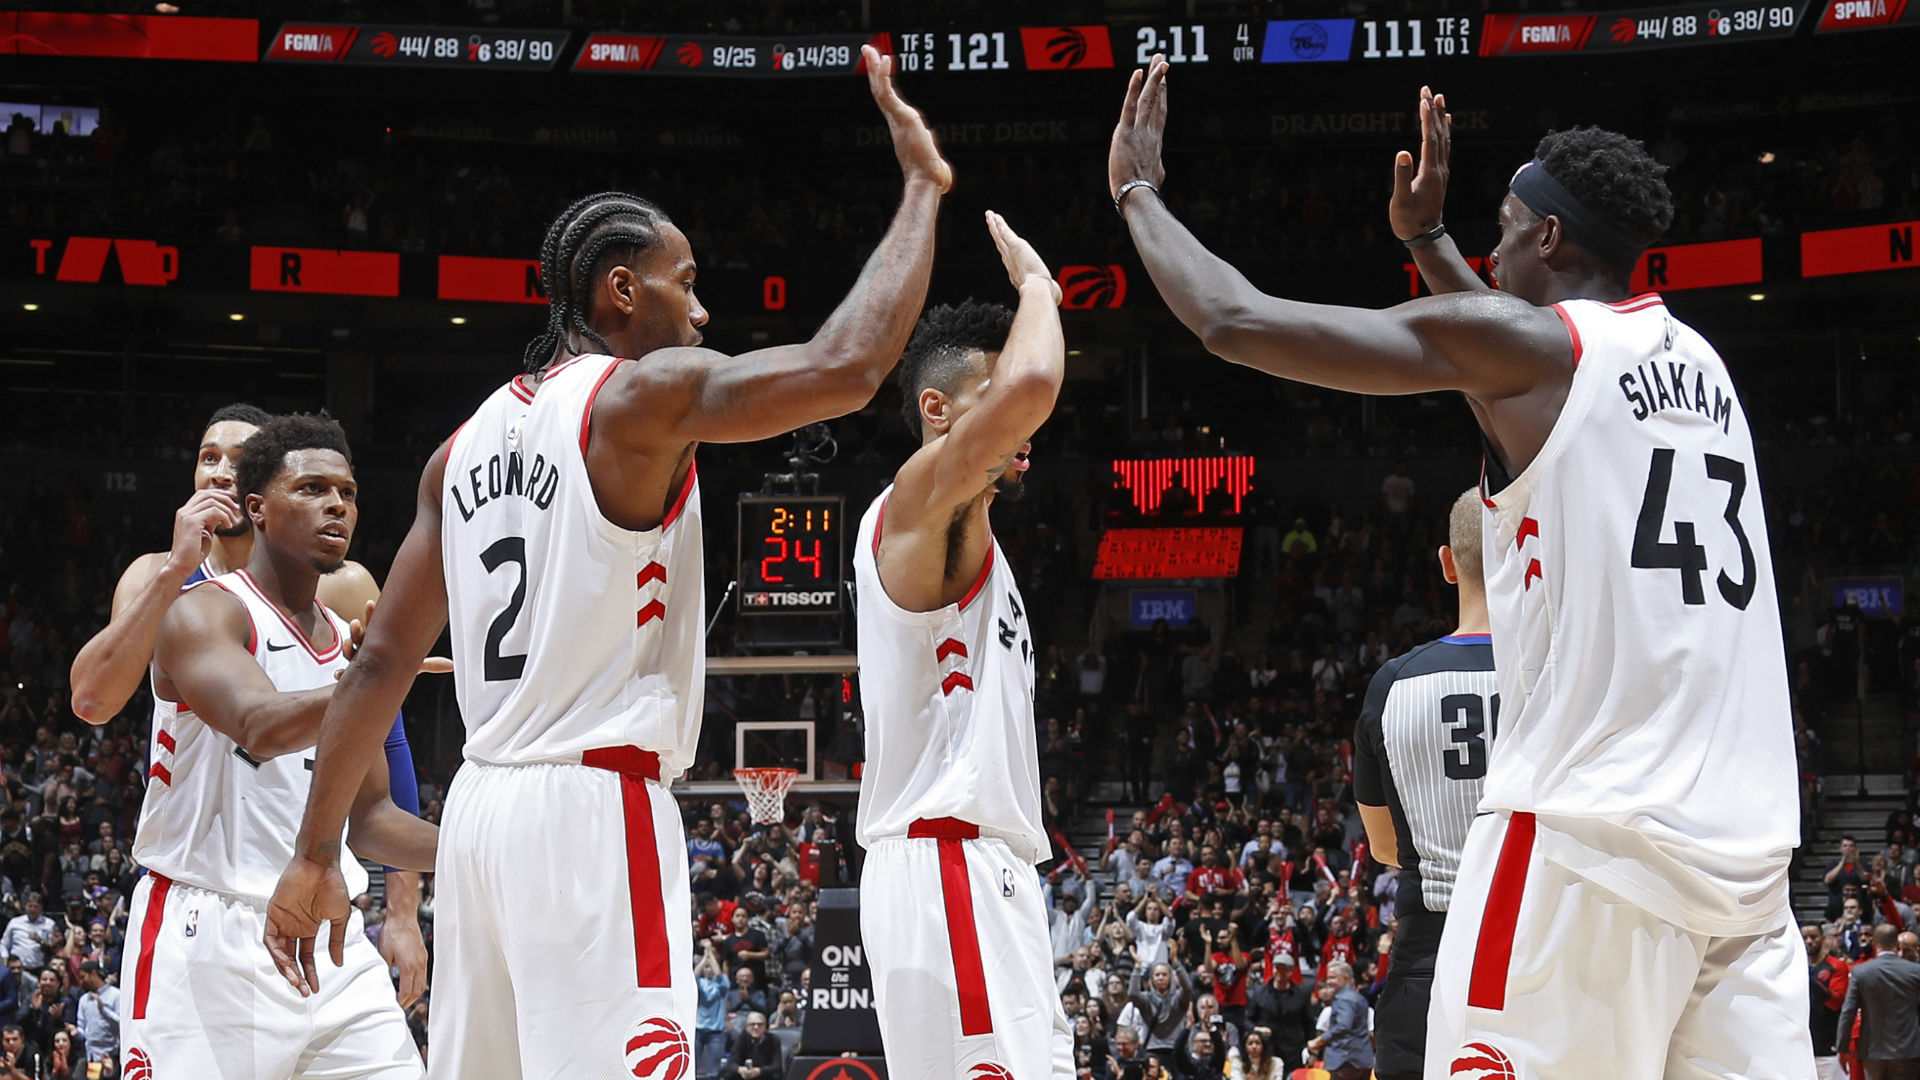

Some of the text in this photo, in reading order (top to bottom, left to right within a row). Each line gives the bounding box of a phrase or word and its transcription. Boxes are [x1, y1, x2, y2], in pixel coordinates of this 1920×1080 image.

[1835, 1, 1887, 19] 3PM/A
[1236, 24, 1249, 45] 4
[1436, 18, 1470, 36] TF 2
[1522, 25, 1571, 44] FGM/A
[284, 34, 333, 52] FGM/A
[901, 34, 934, 52] TF 5
[1136, 25, 1209, 63] 2:11
[1363, 20, 1426, 58] 111
[1434, 37, 1470, 55] TO 1
[590, 43, 640, 62] 3PM/A
[713, 45, 756, 68] 9/25
[797, 45, 849, 67] 14/39
[899, 53, 934, 71] TO 2
[948, 32, 1009, 71] 121
[1233, 46, 1254, 62] QTR
[992, 119, 1068, 142] DECK
[1270, 112, 1402, 134] DRAUGHT
[1648, 252, 1669, 287] R
[1890, 228, 1912, 262] N
[280, 252, 303, 286] R
[1619, 360, 1732, 436] SIAKAM
[771, 507, 829, 534] 2:11
[1631, 447, 1757, 611] 43
[761, 536, 821, 583] 24
[479, 536, 528, 682] 2
[770, 591, 836, 606] TISSOT
[1140, 599, 1185, 620] IBM
[821, 944, 861, 967] ON
[830, 971, 849, 983] the
